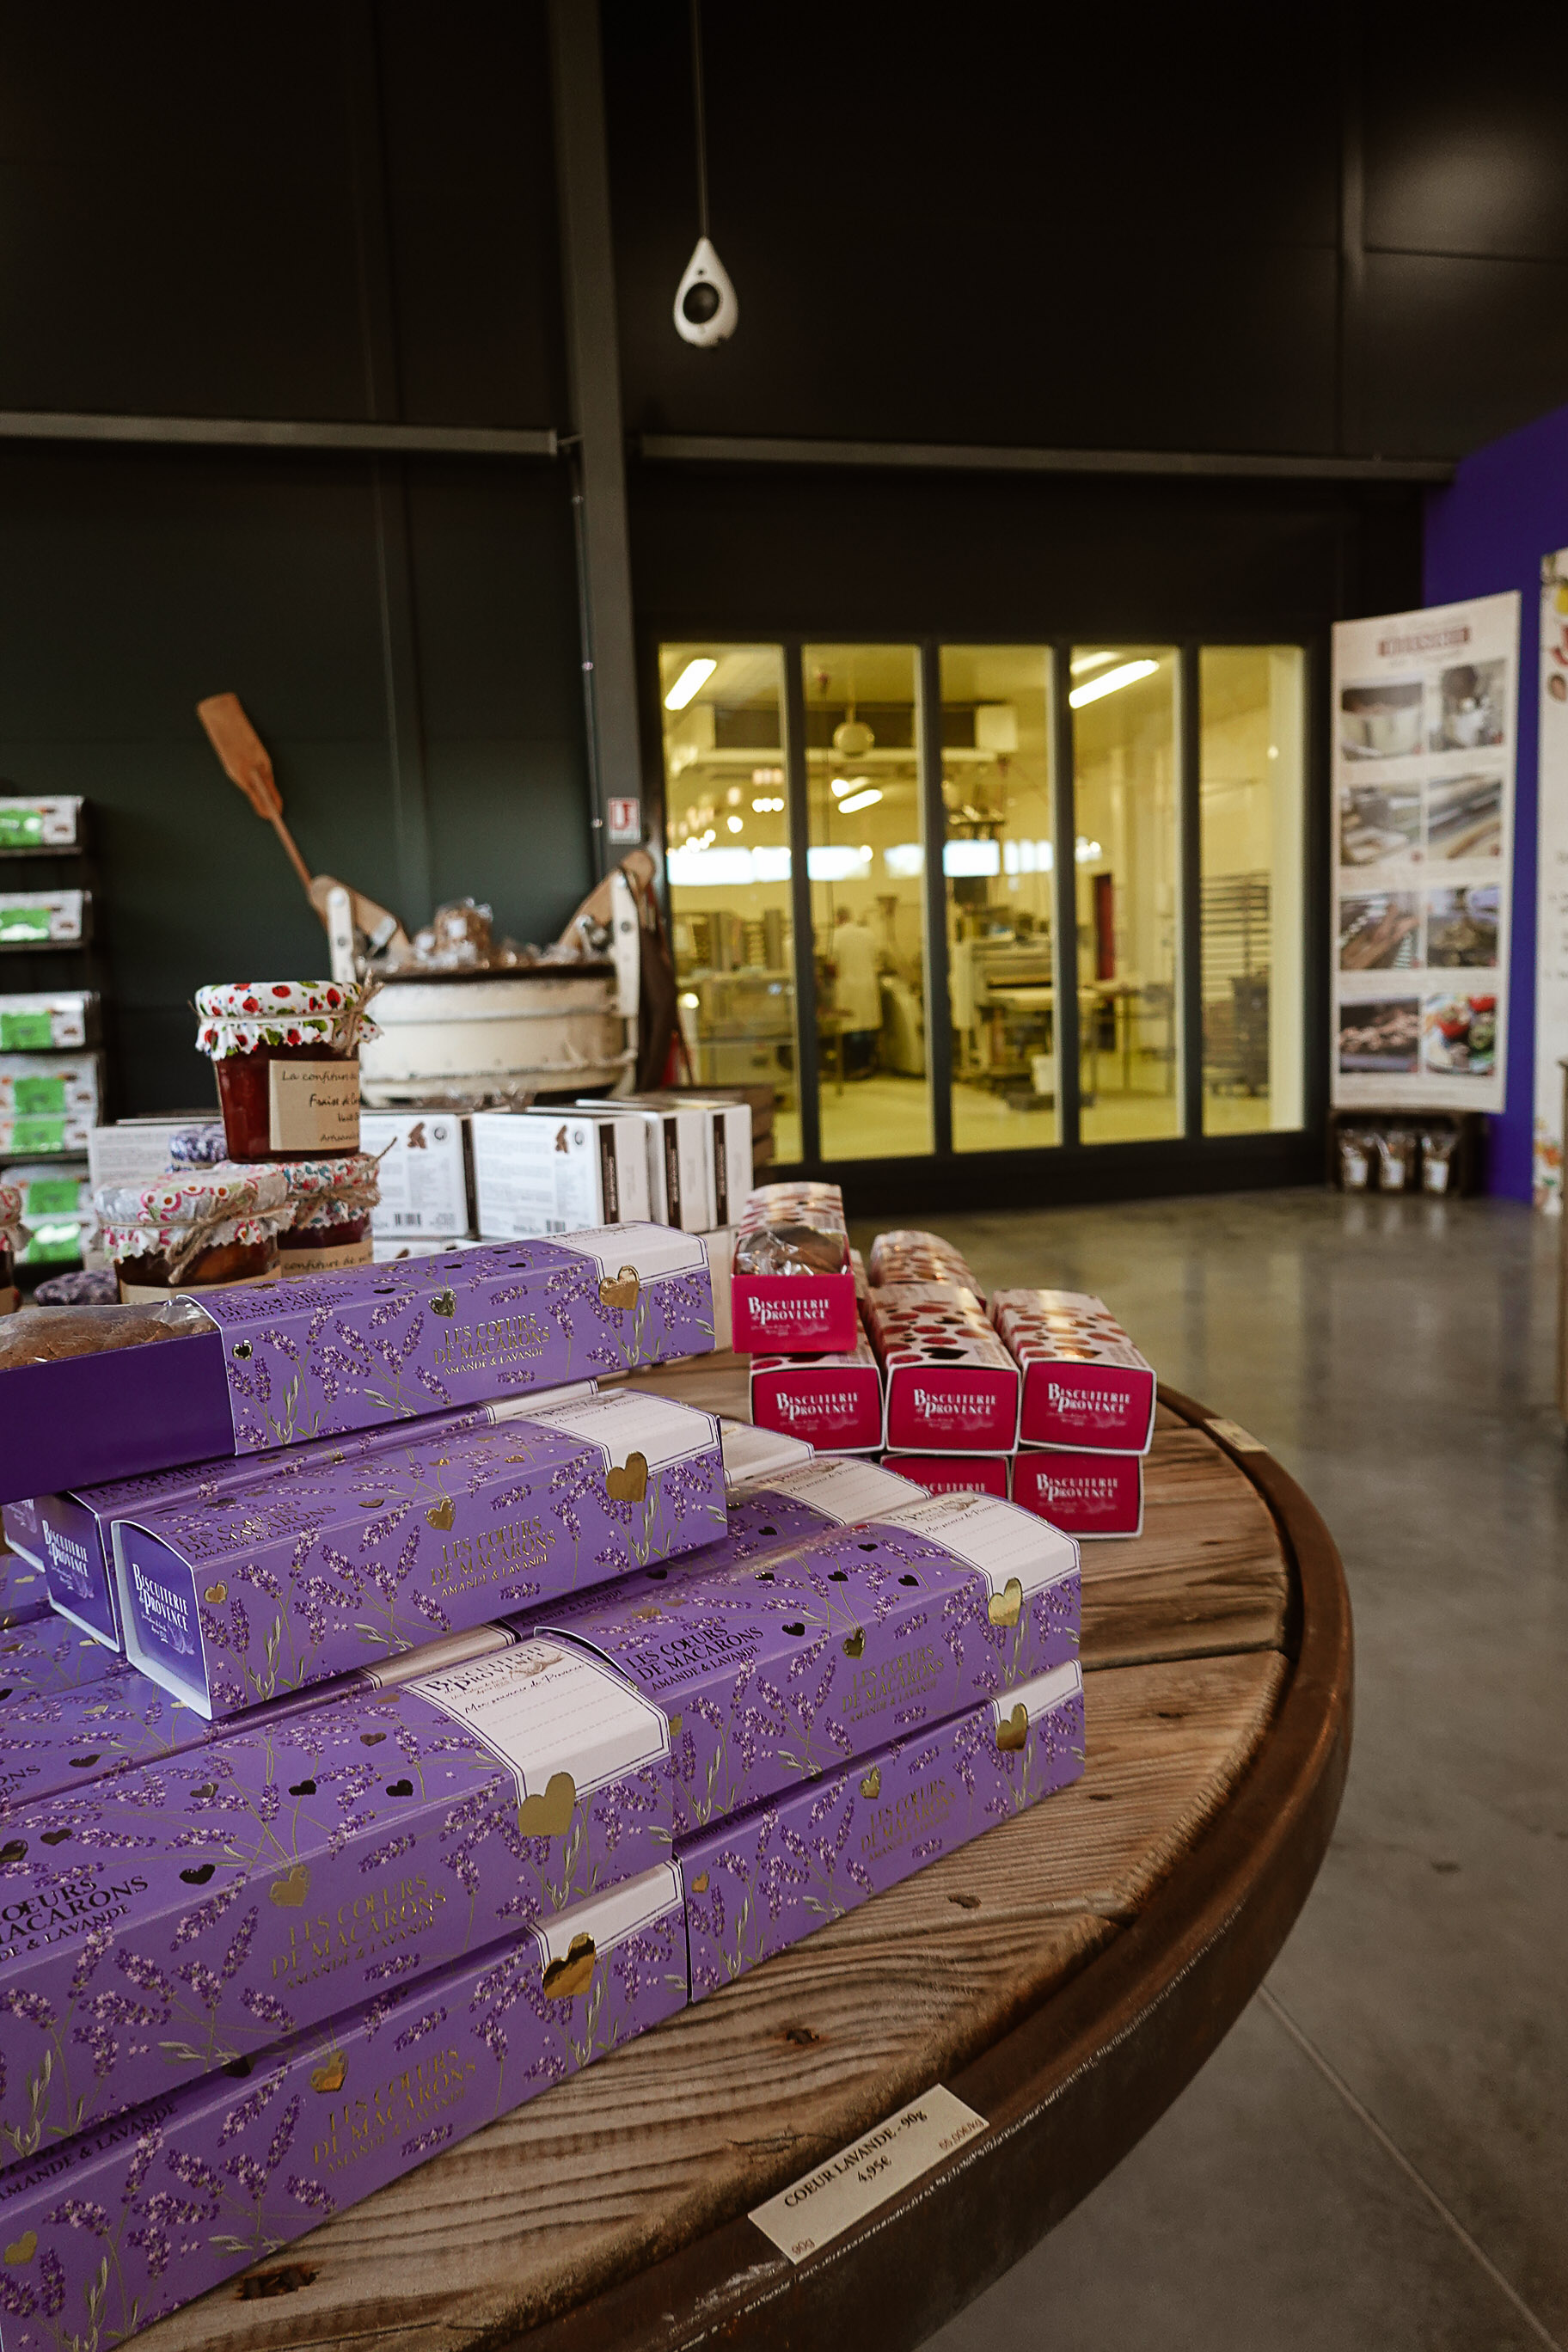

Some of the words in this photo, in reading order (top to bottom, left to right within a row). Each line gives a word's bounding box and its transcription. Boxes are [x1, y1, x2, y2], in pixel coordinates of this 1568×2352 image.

[433, 1344, 456, 1364] DE
[461, 1326, 550, 1359] MACARONS
[444, 1326, 472, 1346] LES
[444, 1358, 487, 1375] AMANDE
[489, 1356, 497, 1366] &
[499, 1346, 544, 1364] LAVANDE
[175, 1530, 214, 1546] LES
[183, 1538, 214, 1553] DE
[217, 1505, 336, 1543] MACARONS
[195, 1539, 252, 1559] AMANDE
[267, 1517, 324, 1538] LAVANDE
[442, 1537, 472, 1562] LES
[431, 1562, 453, 1586] DE
[460, 1529, 556, 1575] MACARONS
[441, 1574, 487, 1598] AMANDE
[492, 1570, 499, 1581] &
[502, 1553, 548, 1576] LAVANDE
[132, 1563, 188, 1616] BISCUITERIE
[143, 1589, 188, 1632] PROVENCE
[425, 1645, 542, 1691] BISCUITERIE
[626, 1650, 659, 1669] LES
[660, 1625, 728, 1656] CŒURS
[636, 1662, 666, 1681] DE
[664, 1626, 763, 1670] MACARONS
[652, 1666, 701, 1691] AMANDE
[701, 1663, 711, 1672] &
[710, 1645, 761, 1669] LAVANDE
[453, 1651, 545, 1691] PROVENCE
[842, 1693, 861, 1713] DE
[866, 1657, 944, 1700] MACARONS
[853, 1666, 877, 1690] LES
[465, 1701, 489, 1714] Mon
[0, 1877, 96, 1926] ŒURS
[0, 1876, 149, 1945] ACARONS
[28, 1939, 40, 1950] &
[45, 1904, 131, 1944] LAVANDE
[273, 1950, 302, 1979] DE
[313, 1885, 446, 1959] MACARONS
[290, 1912, 330, 1946] LES
[285, 1953, 348, 1990] AMANDE
[371, 1916, 435, 1954] LAVANDE
[80, 2146, 93, 2160] &
[96, 2104, 179, 2150] LAVANDE
[314, 2135, 340, 2164] DE
[352, 2060, 475, 2142] MACARONS
[330, 2099, 367, 2132] LES
[784, 2169, 836, 2208] COEUR
[834, 2126, 897, 2174] LAVANDE
[857, 2155, 892, 2184] 4,95€
